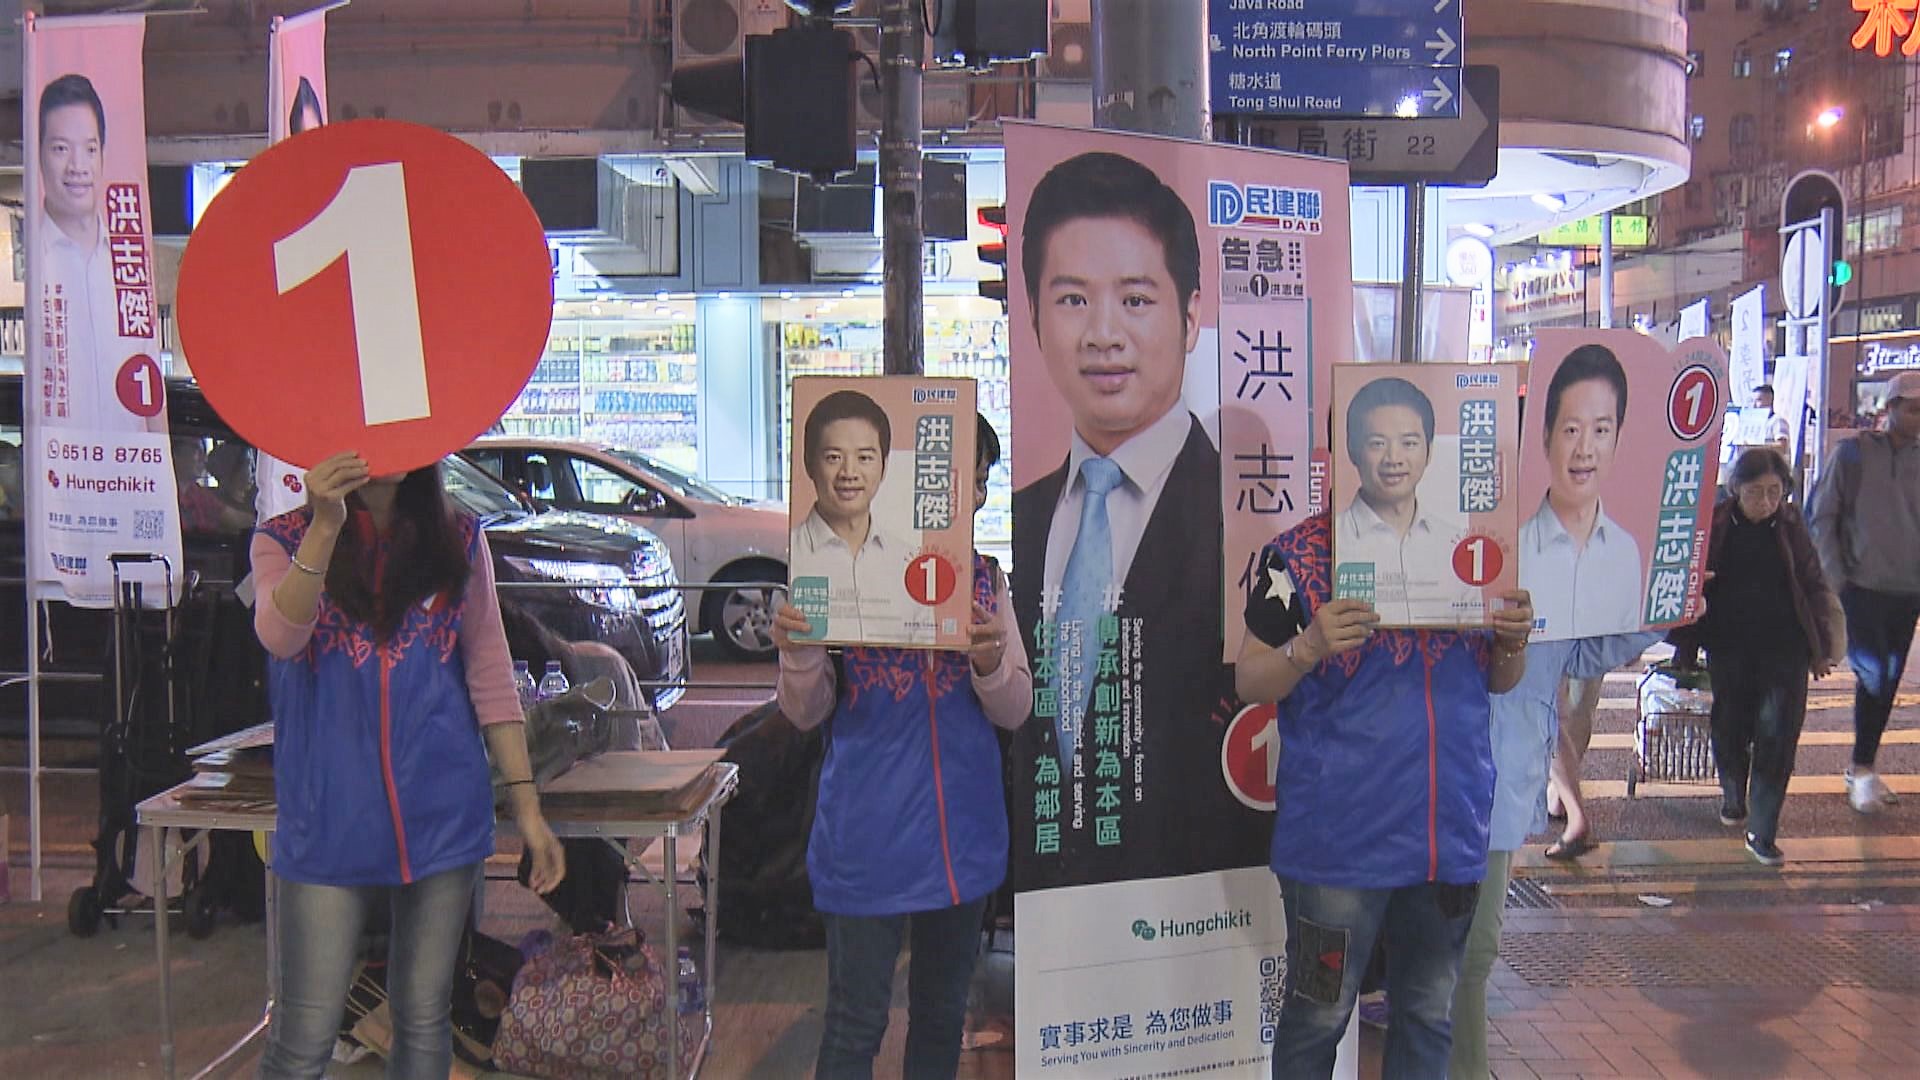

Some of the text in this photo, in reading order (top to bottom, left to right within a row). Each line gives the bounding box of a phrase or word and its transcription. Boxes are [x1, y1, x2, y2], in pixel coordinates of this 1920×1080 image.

[1267, 0, 1304, 10] Road
[1233, 22, 1342, 40] 北角渡輪碼頭
[1232, 44, 1411, 62] North Point Ferry Piers
[1228, 71, 1282, 91] 糖水道
[1229, 96, 1341, 110] Tong Shui Road
[1257, 126, 1435, 161] 局街 22
[1246, 186, 1320, 219] 民建聯
[1282, 220, 1320, 232] DAB
[107, 186, 152, 335] 洪志傑
[273, 161, 430, 426] 1
[134, 364, 152, 405] 1
[1684, 381, 1704, 427] 1
[62, 444, 163, 464] 6518 8765
[1462, 401, 1494, 512] 洪志傑
[66, 473, 156, 493] Hungchikit
[915, 417, 952, 529] 洪志傑
[1648, 453, 1701, 622] 洪志傑
[1467, 539, 1484, 583] 1
[919, 557, 937, 602] 1
[1071, 620, 1083, 658] Living
[1132, 617, 1143, 658] Serving
[1073, 663, 1083, 674] in
[1133, 662, 1143, 681] the
[1073, 680, 1083, 701] the
[1073, 753, 1084, 778] and
[1132, 753, 1143, 783] focus
[1251, 718, 1280, 785] 1
[1071, 782, 1083, 830] serving
[1133, 787, 1142, 802] on
[1160, 908, 1252, 939] Hungchikit
[1040, 1000, 1233, 1051] 實事求是 為您做事
[1041, 1029, 1234, 1067] Serving You with Sincerity and Dedication
